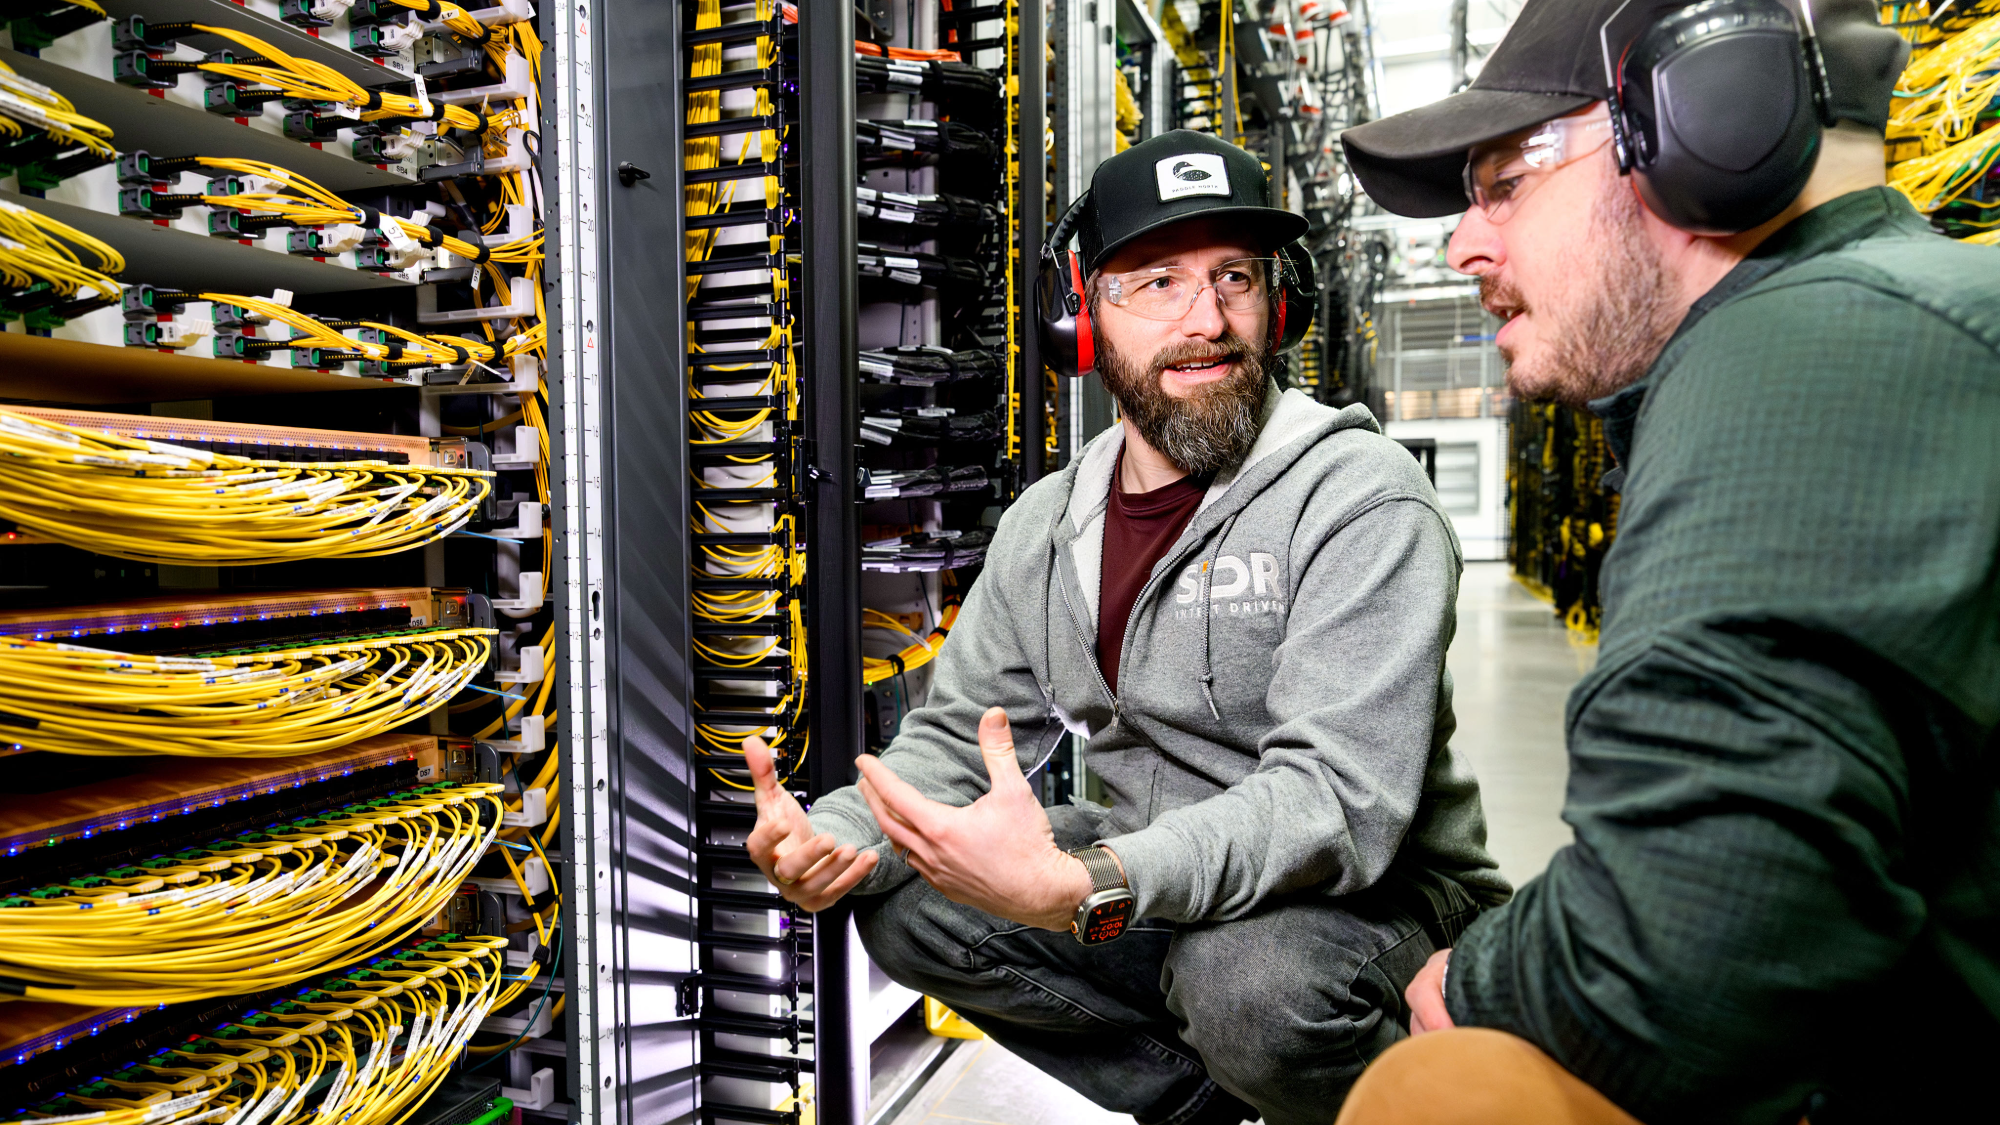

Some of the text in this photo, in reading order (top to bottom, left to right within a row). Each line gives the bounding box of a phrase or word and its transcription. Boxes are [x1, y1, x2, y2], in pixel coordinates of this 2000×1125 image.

[392, 60, 404, 71] SB3
[584, 61, 590, 75] 23
[585, 114, 592, 128] 22
[396, 165, 408, 175] SB4
[588, 166, 594, 180] 21
[588, 219, 594, 232] 20
[388, 226, 404, 240] 57
[590, 270, 596, 283] 19
[592, 374, 598, 386] 17
[592, 426, 598, 438] 16
[594, 476, 600, 488] 15
[594, 528, 601, 540] 14
[596, 578, 602, 590] 13
[1176, 604, 1220, 619] INTET
[574, 734, 581, 742] 10
[600, 728, 606, 742] 10
[420, 768, 430, 777] DS7
[575, 784, 582, 793] 09
[576, 834, 584, 844] 08
[578, 885, 584, 894] 07
[579, 935, 586, 944] 06
[580, 985, 588, 994] 05
[581, 1034, 588, 1044] 04
[606, 1028, 614, 1040] 04
[582, 1084, 590, 1093] 03
